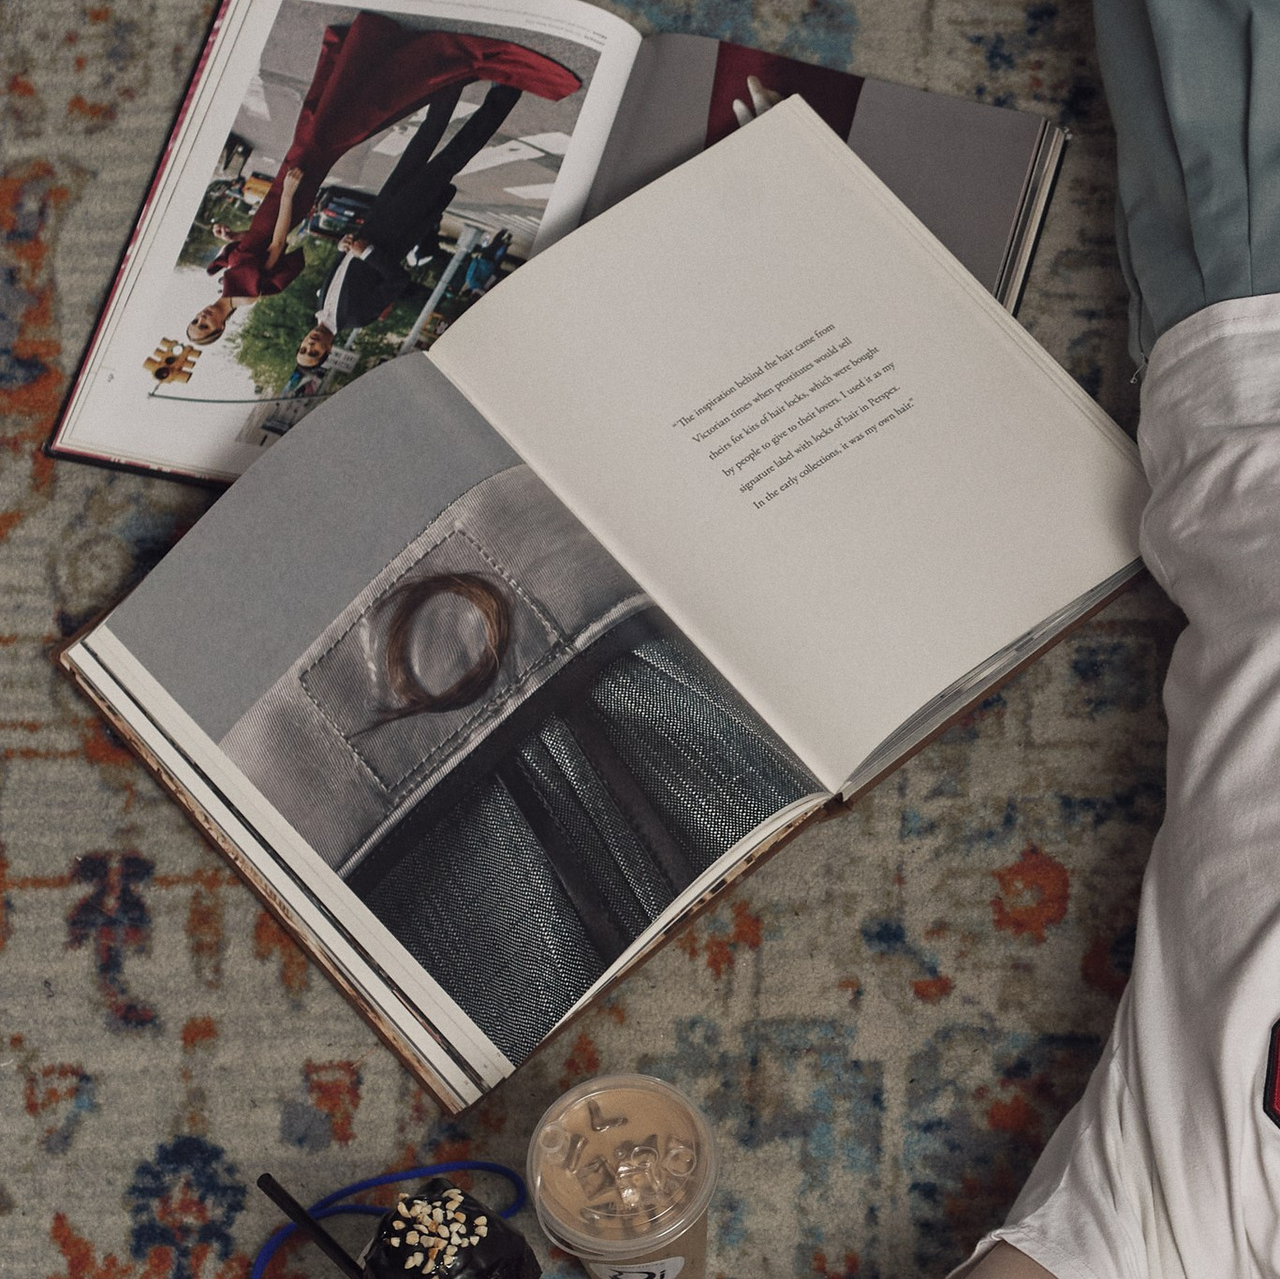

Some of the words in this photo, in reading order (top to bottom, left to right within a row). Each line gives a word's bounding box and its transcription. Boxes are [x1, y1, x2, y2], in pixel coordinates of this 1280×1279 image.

[691, 416, 731, 443] Victorian
[730, 402, 753, 418] times
[752, 388, 775, 403] when
[774, 363, 814, 392] prostitutes
[813, 345, 839, 364] would
[838, 336, 852, 349] sell
[693, 386, 737, 416] inspiration
[734, 366, 765, 388] behind
[764, 360, 778, 371] the
[775, 349, 794, 362] hair
[795, 336, 816, 351] came
[814, 324, 836, 339] from
[709, 442, 732, 460] theirs
[730, 433, 744, 444] for
[742, 423, 760, 435] kits
[760, 413, 769, 425] of
[767, 405, 786, 419] hair
[783, 393, 810, 408] locks,
[808, 375, 833, 393] which
[832, 364, 852, 378] were
[849, 347, 879, 367] bought
[721, 466, 735, 477] by
[735, 448, 762, 471] people
[761, 442, 771, 450] to
[771, 430, 788, 446] give
[787, 425, 798, 433] to
[797, 412, 817, 426] their
[814, 398, 842, 414] lovers.
[846, 379, 866, 395] used
[873, 371, 882, 379] as
[882, 362, 895, 373] my
[739, 465, 775, 493] signature
[772, 450, 795, 468] label
[794, 439, 813, 454] with
[810, 427, 834, 443] locks
[834, 417, 843, 429] of
[840, 410, 859, 424] hair
[858, 404, 870, 413] in
[867, 386, 901, 407] Perspex.
[753, 500, 766, 509] In
[765, 489, 779, 501] the
[779, 476, 799, 492] early
[799, 449, 842, 478] collections,
[848, 433, 865, 445] was
[864, 424, 878, 436] my
[878, 413, 896, 427] own
